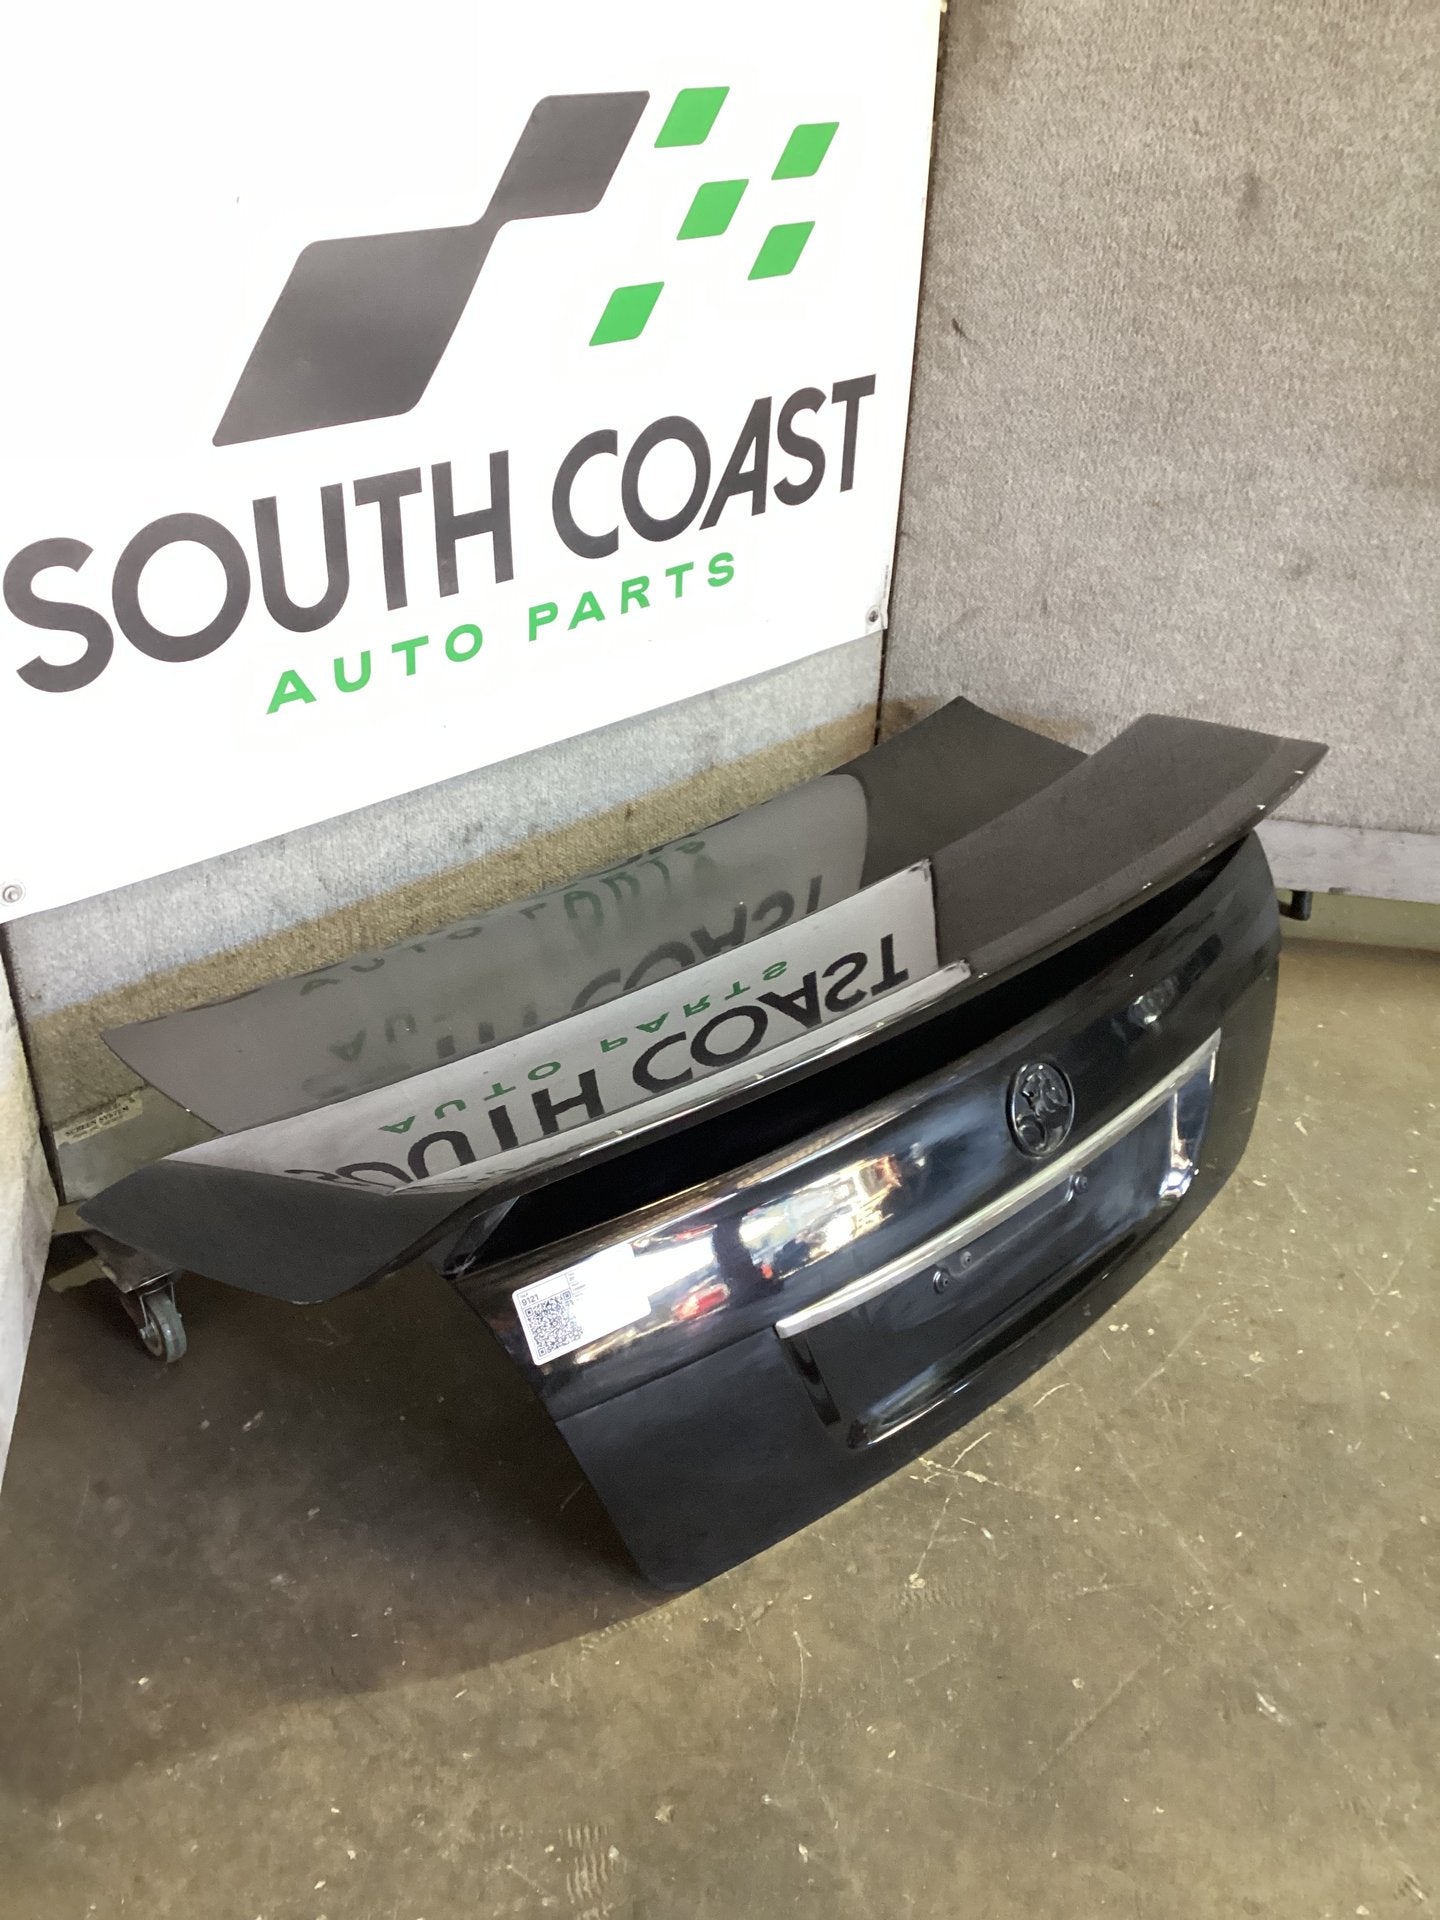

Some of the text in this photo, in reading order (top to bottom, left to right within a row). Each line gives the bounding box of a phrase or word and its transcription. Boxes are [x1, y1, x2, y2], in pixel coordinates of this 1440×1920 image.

[3, 373, 877, 693] SOUTH COAST
[266, 551, 736, 715] AUTO PARTS
